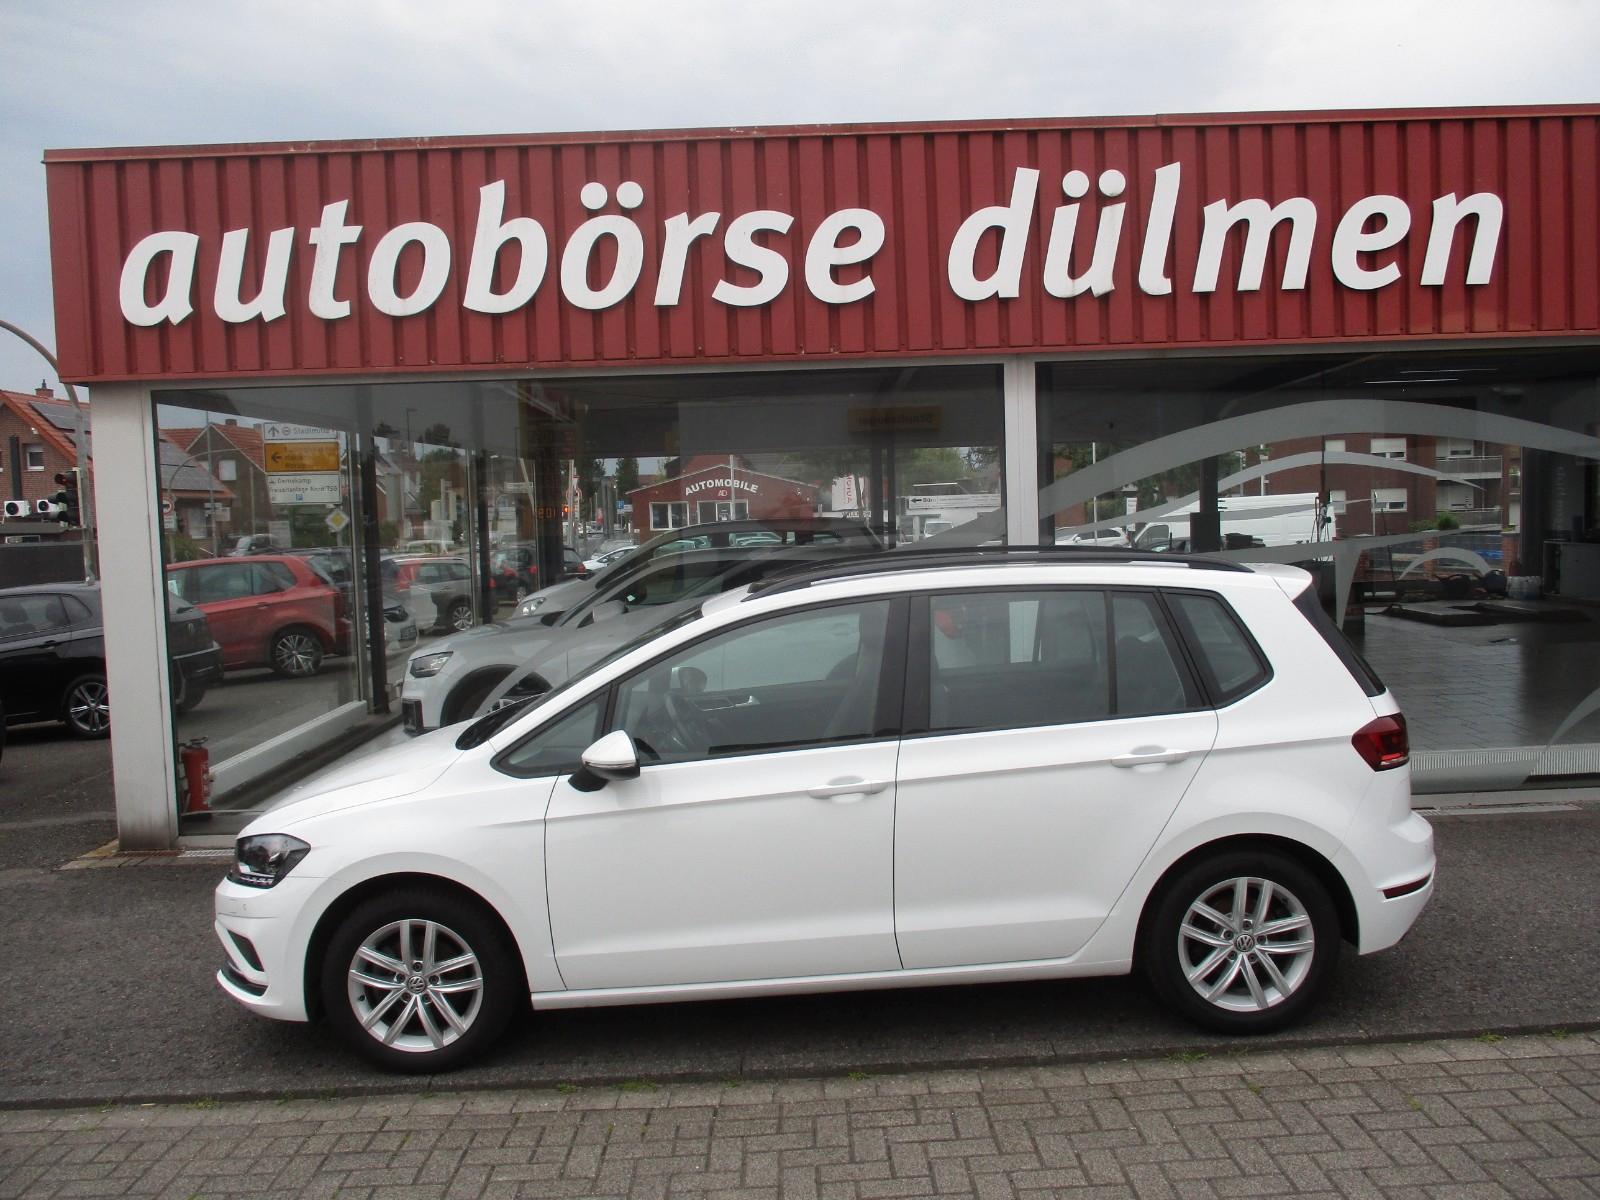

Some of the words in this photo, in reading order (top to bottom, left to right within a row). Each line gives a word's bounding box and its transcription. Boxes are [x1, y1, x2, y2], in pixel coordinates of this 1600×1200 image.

[119, 179, 886, 328] autobörse
[947, 161, 1504, 301] dülmen
[685, 479, 759, 496] AUTOMOBILE
